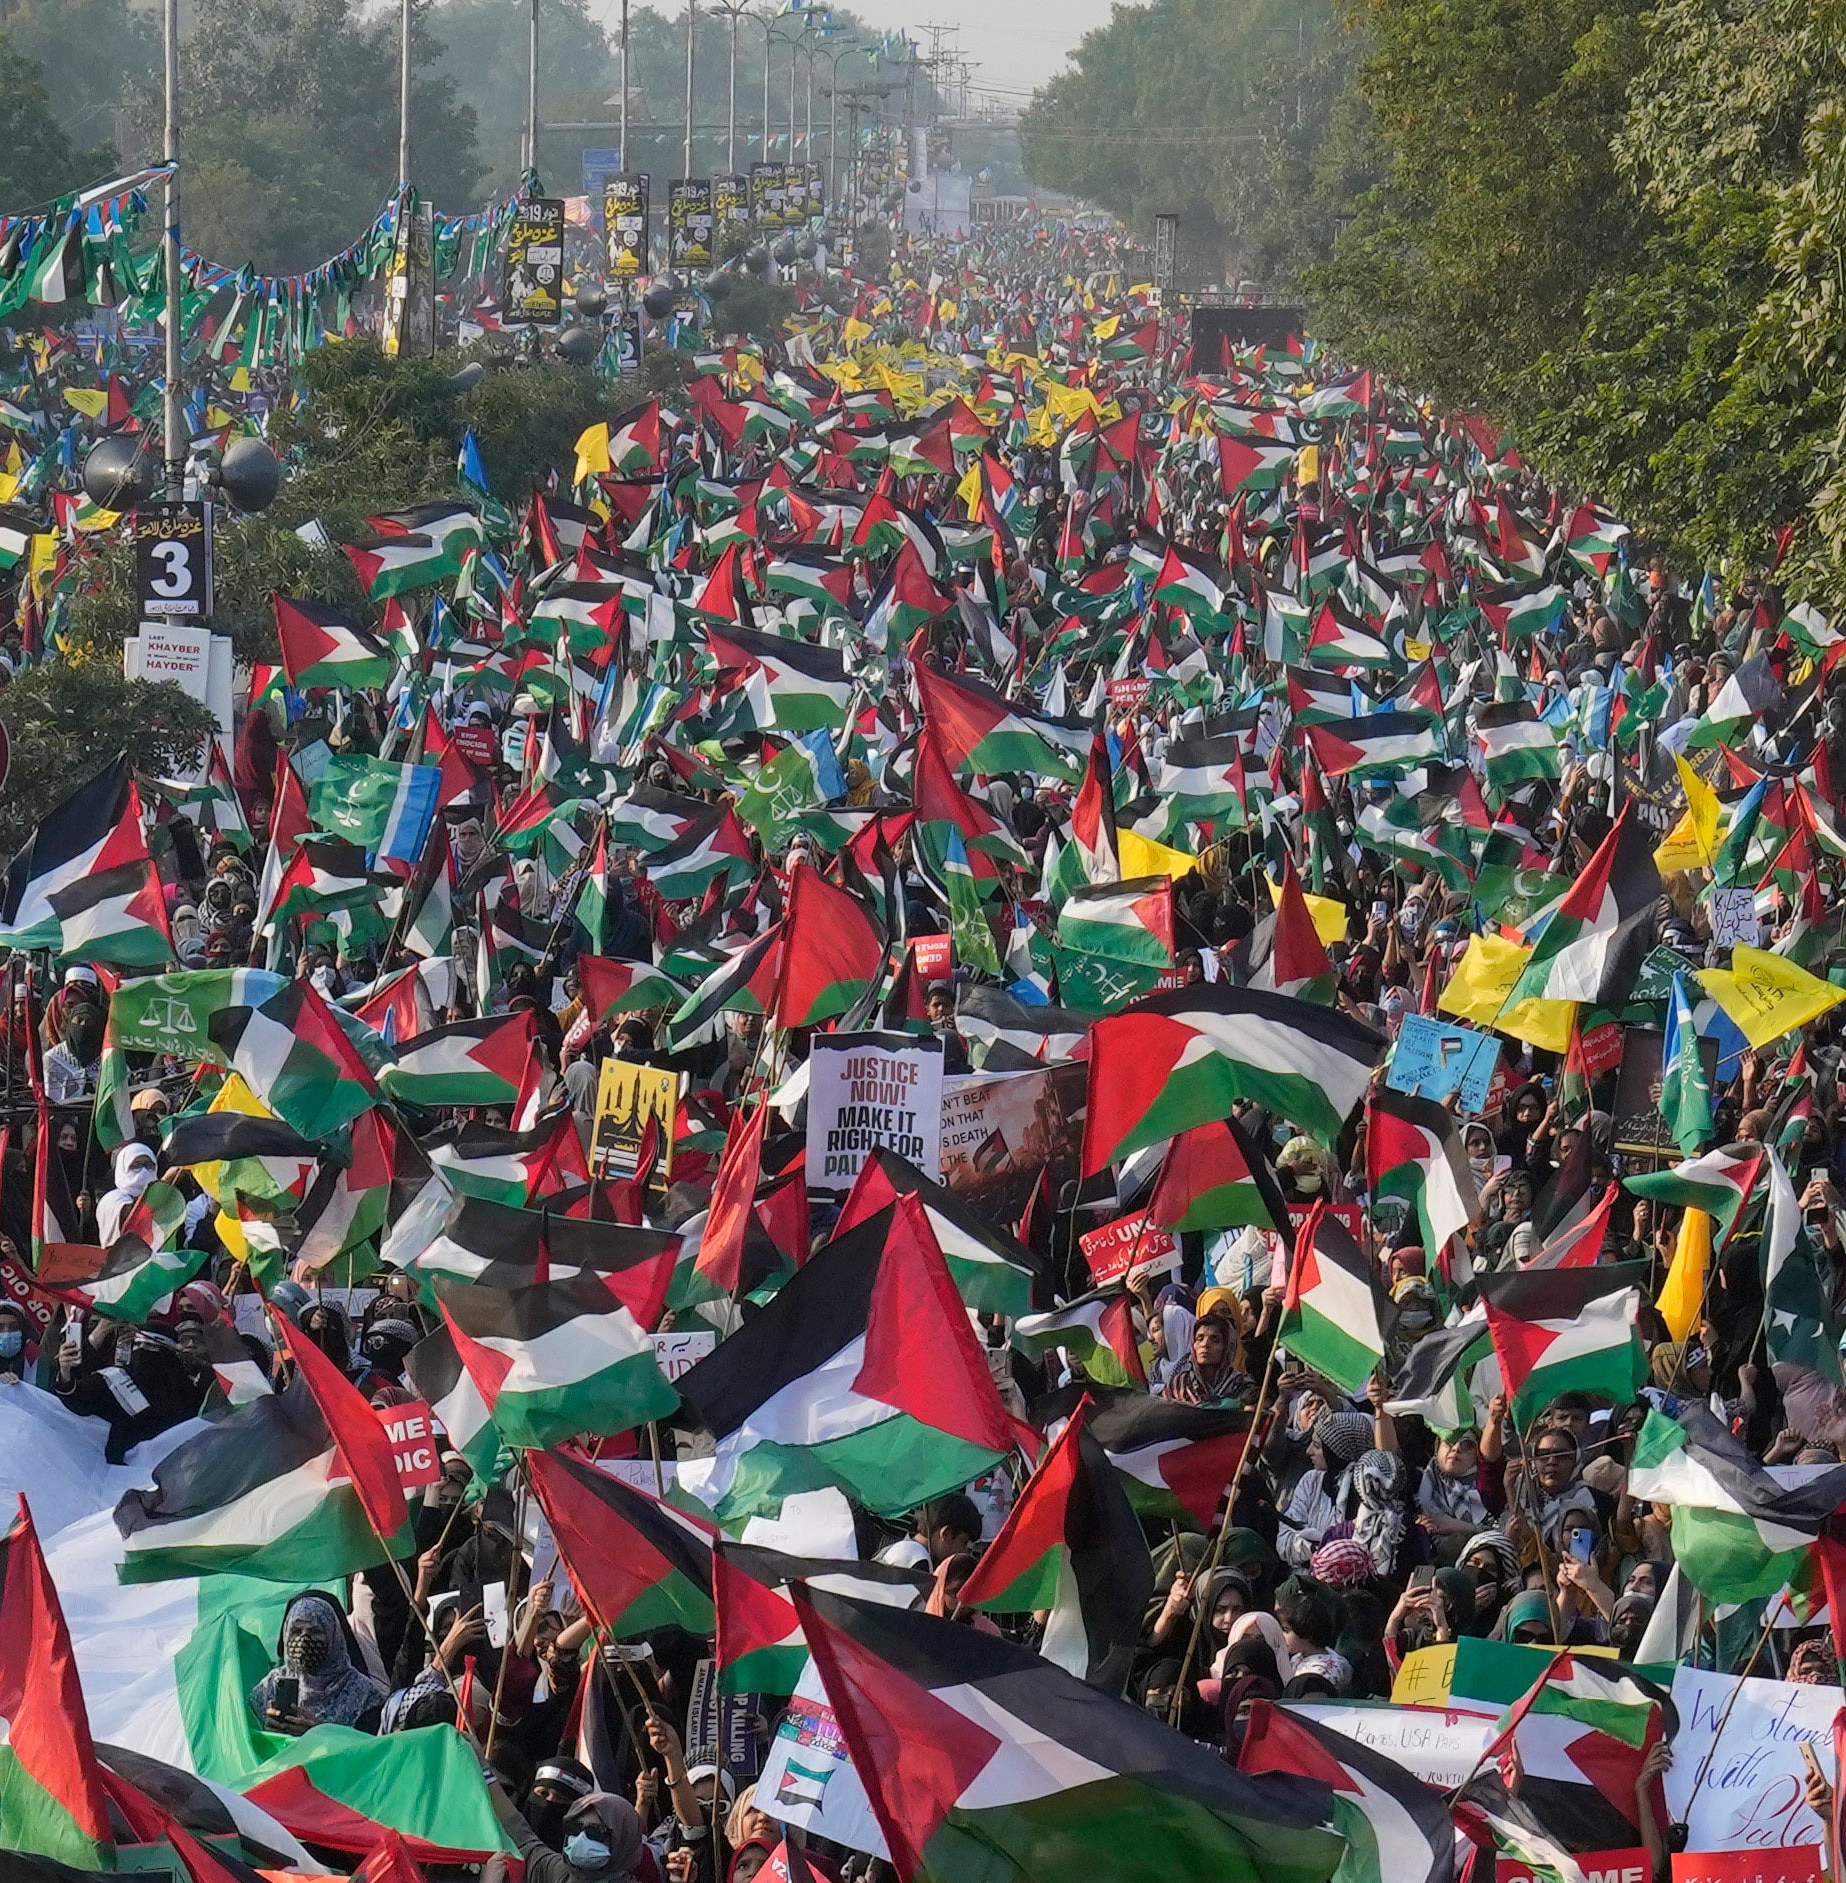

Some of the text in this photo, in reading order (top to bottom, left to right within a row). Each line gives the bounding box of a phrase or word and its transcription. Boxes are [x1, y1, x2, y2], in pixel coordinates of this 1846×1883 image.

[618, 182, 627, 197] 19
[529, 204, 541, 220] 19
[151, 541, 193, 598] 3
[148, 643, 201, 654] KHAYBER
[146, 660, 194, 671] HAYDER
[840, 1057, 918, 1085] JUSTICE
[850, 1079, 906, 1106] NOW!
[964, 1089, 992, 1107] BEAT
[837, 1106, 917, 1133] MAKE IT
[957, 1109, 985, 1125] THAT
[826, 1129, 924, 1158] RIGHT FOR
[951, 1127, 989, 1147] DEATH
[948, 1152, 968, 1165] THE
[730, 1708, 749, 1763] KILLING
[1401, 1727, 1432, 1750] USA
